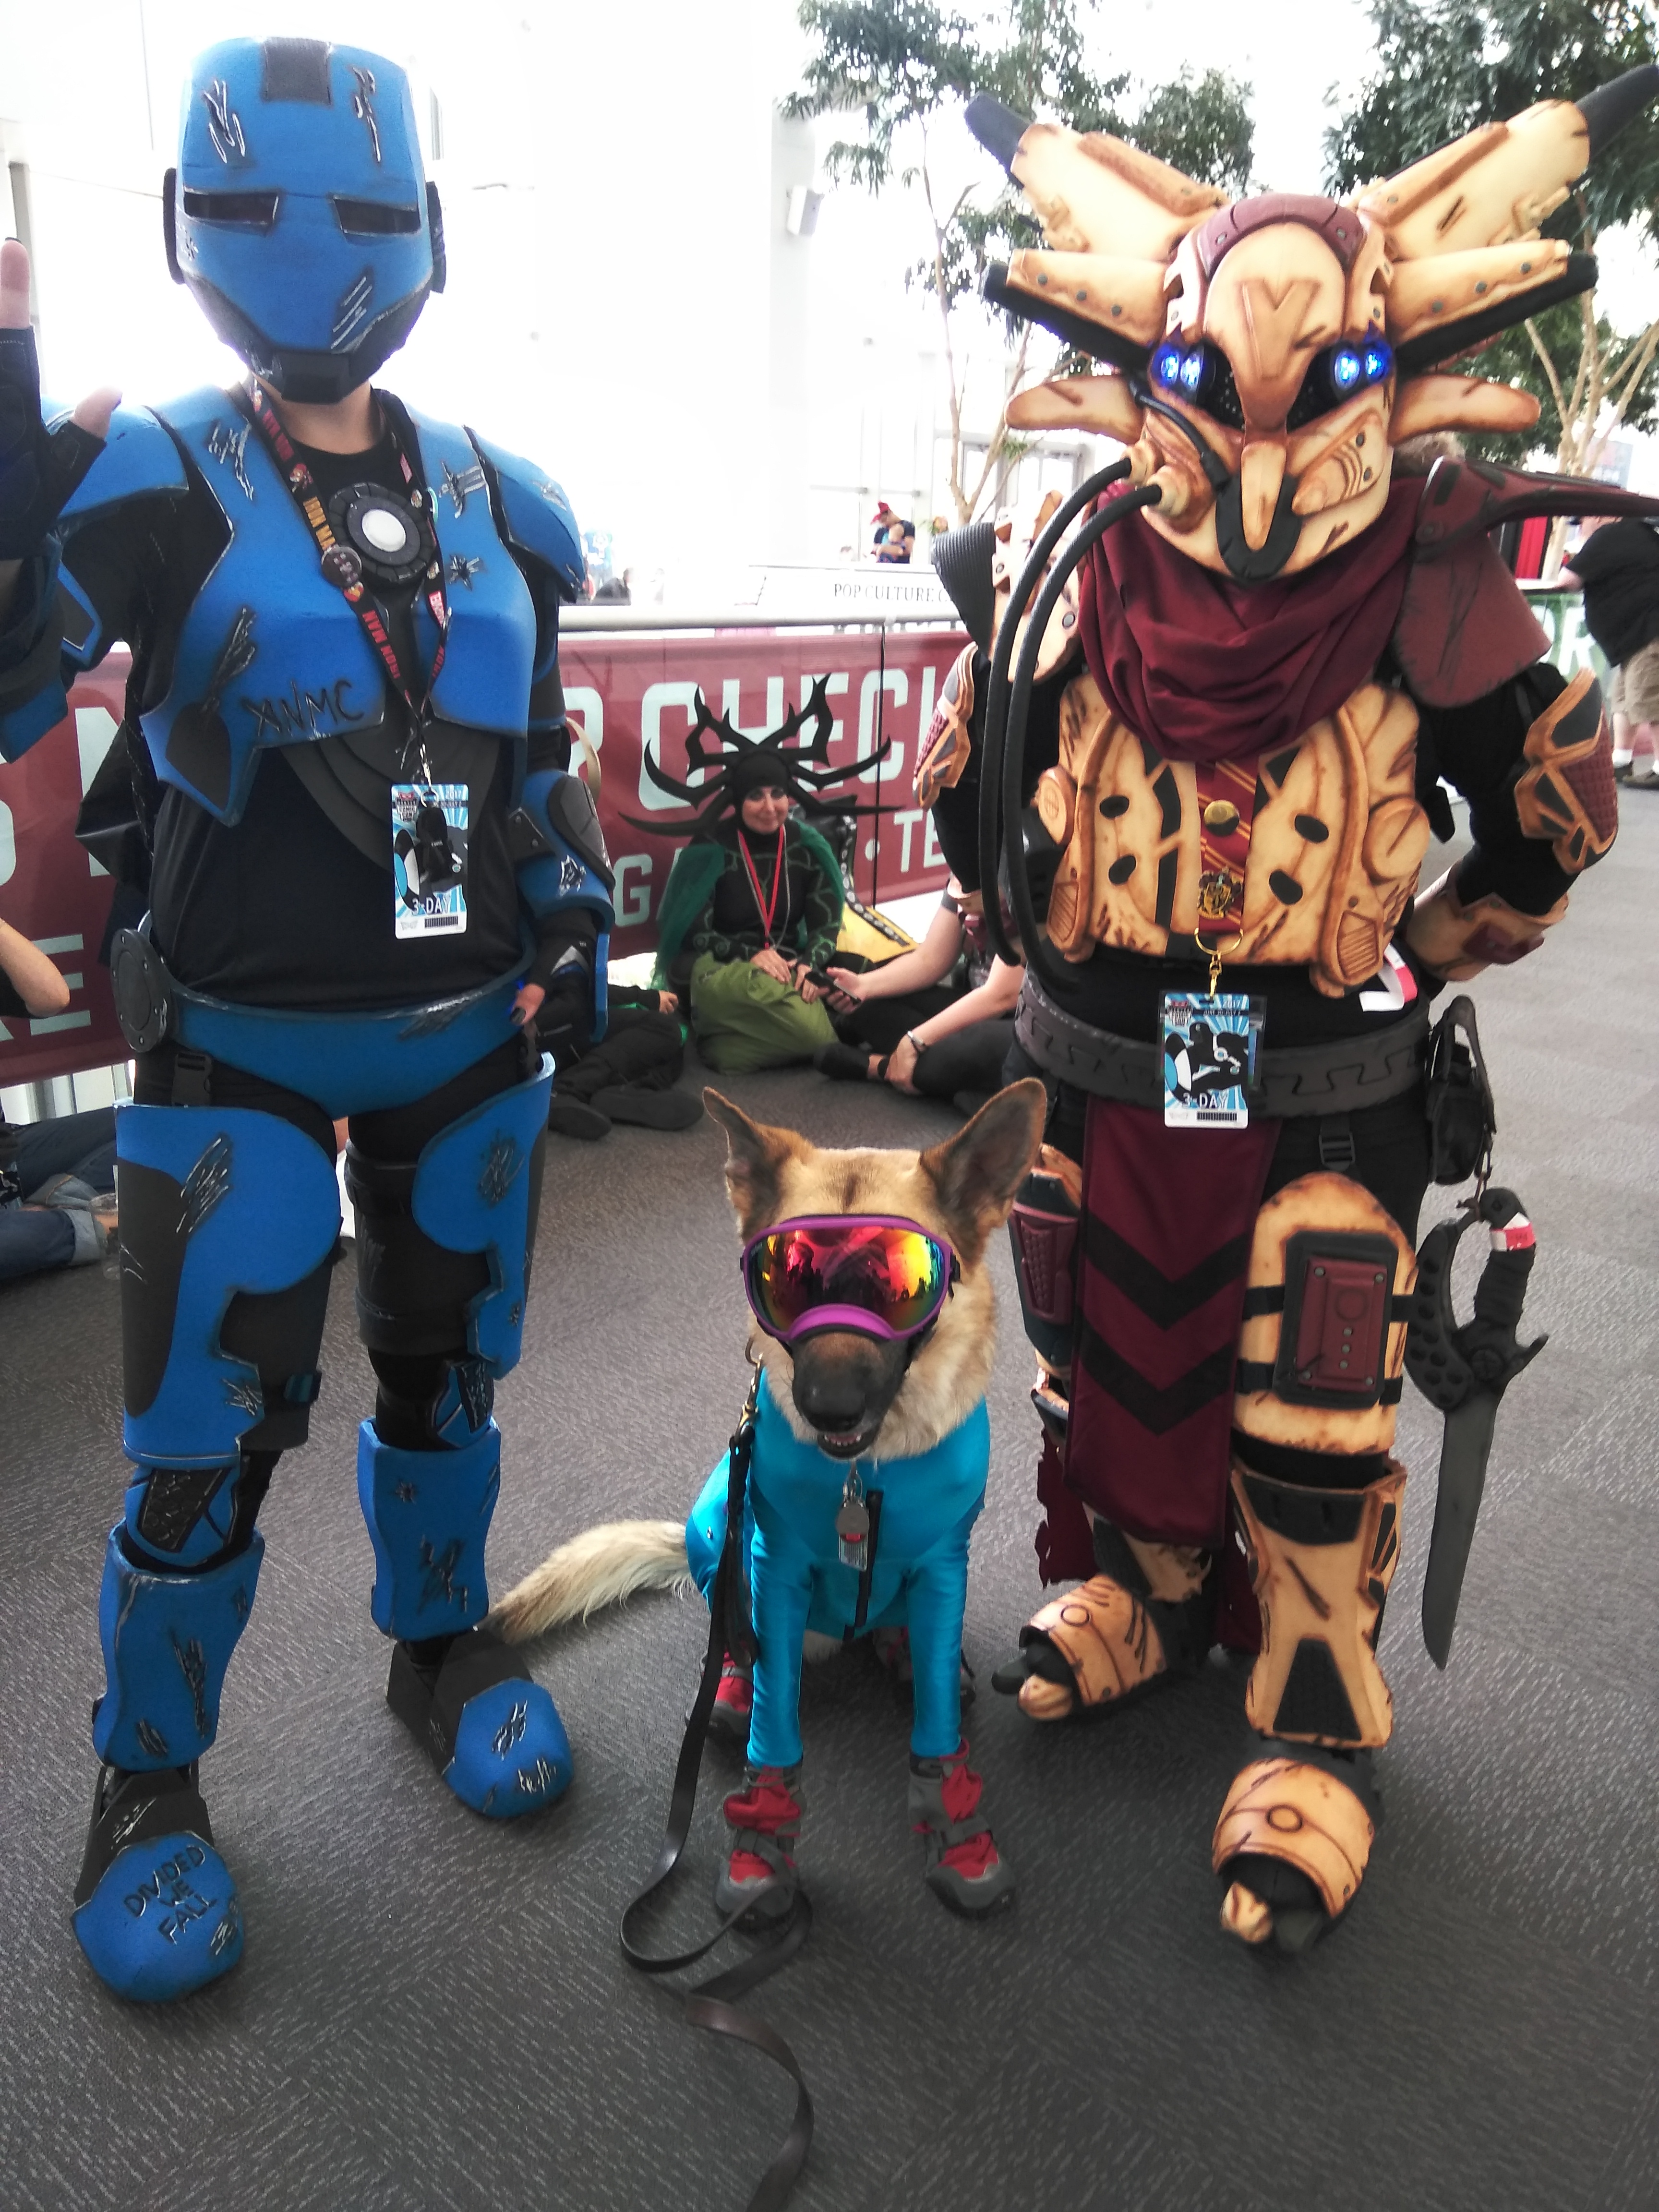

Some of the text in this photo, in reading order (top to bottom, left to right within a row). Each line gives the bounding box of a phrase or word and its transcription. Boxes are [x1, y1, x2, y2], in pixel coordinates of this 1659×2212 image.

[834, 583, 861, 598] POP
[865, 585, 934, 602] CULTURE
[362, 610, 388, 644] MAN
[411, 896, 450, 916] 3-DAY
[1182, 1092, 1228, 1109] 3-DAY
[158, 1893, 217, 1945] FALL
